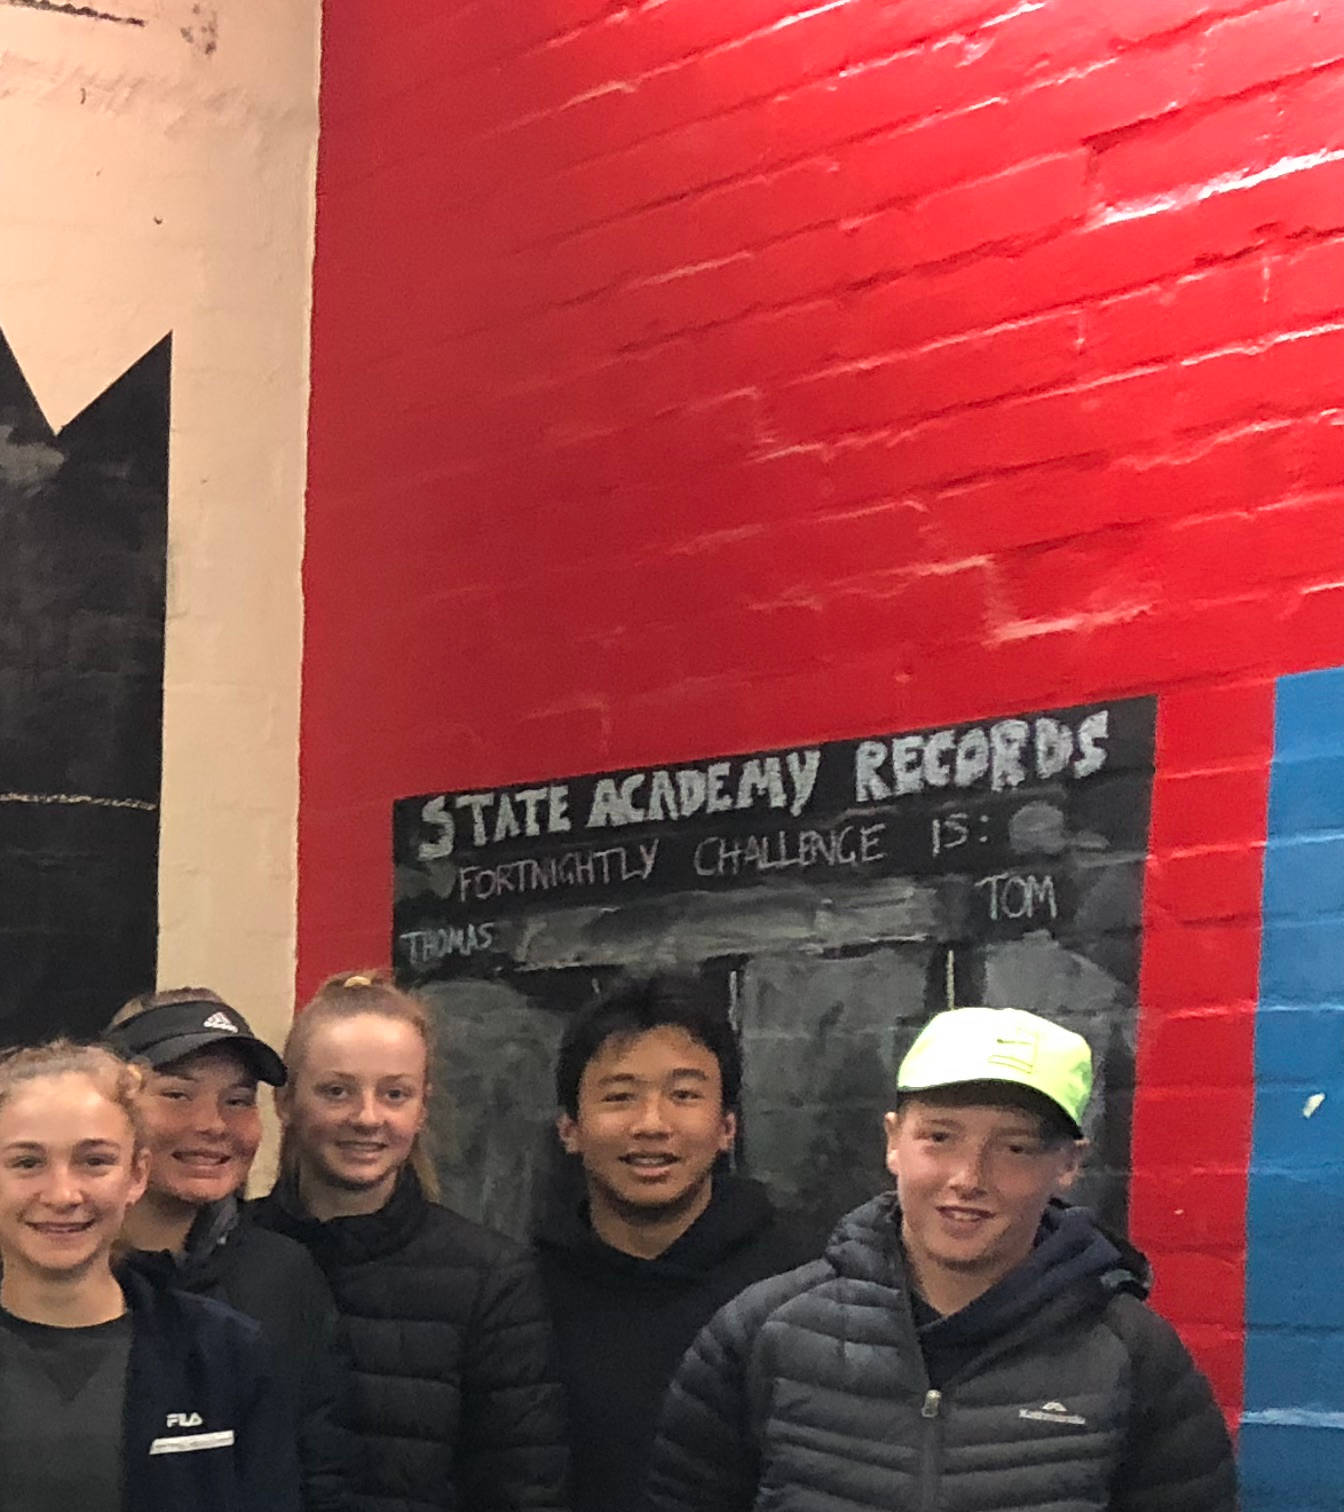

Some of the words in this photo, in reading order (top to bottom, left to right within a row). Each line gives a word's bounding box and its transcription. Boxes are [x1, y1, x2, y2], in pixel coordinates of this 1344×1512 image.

[417, 783, 572, 862] STATE
[586, 747, 821, 829] ACADEMY
[855, 709, 1110, 803] RECORDS
[459, 837, 660, 903] FORTNIGHTLY
[693, 822, 887, 877] CHALLENGE
[974, 871, 1059, 922] TOM
[399, 920, 497, 964] THOMAS
